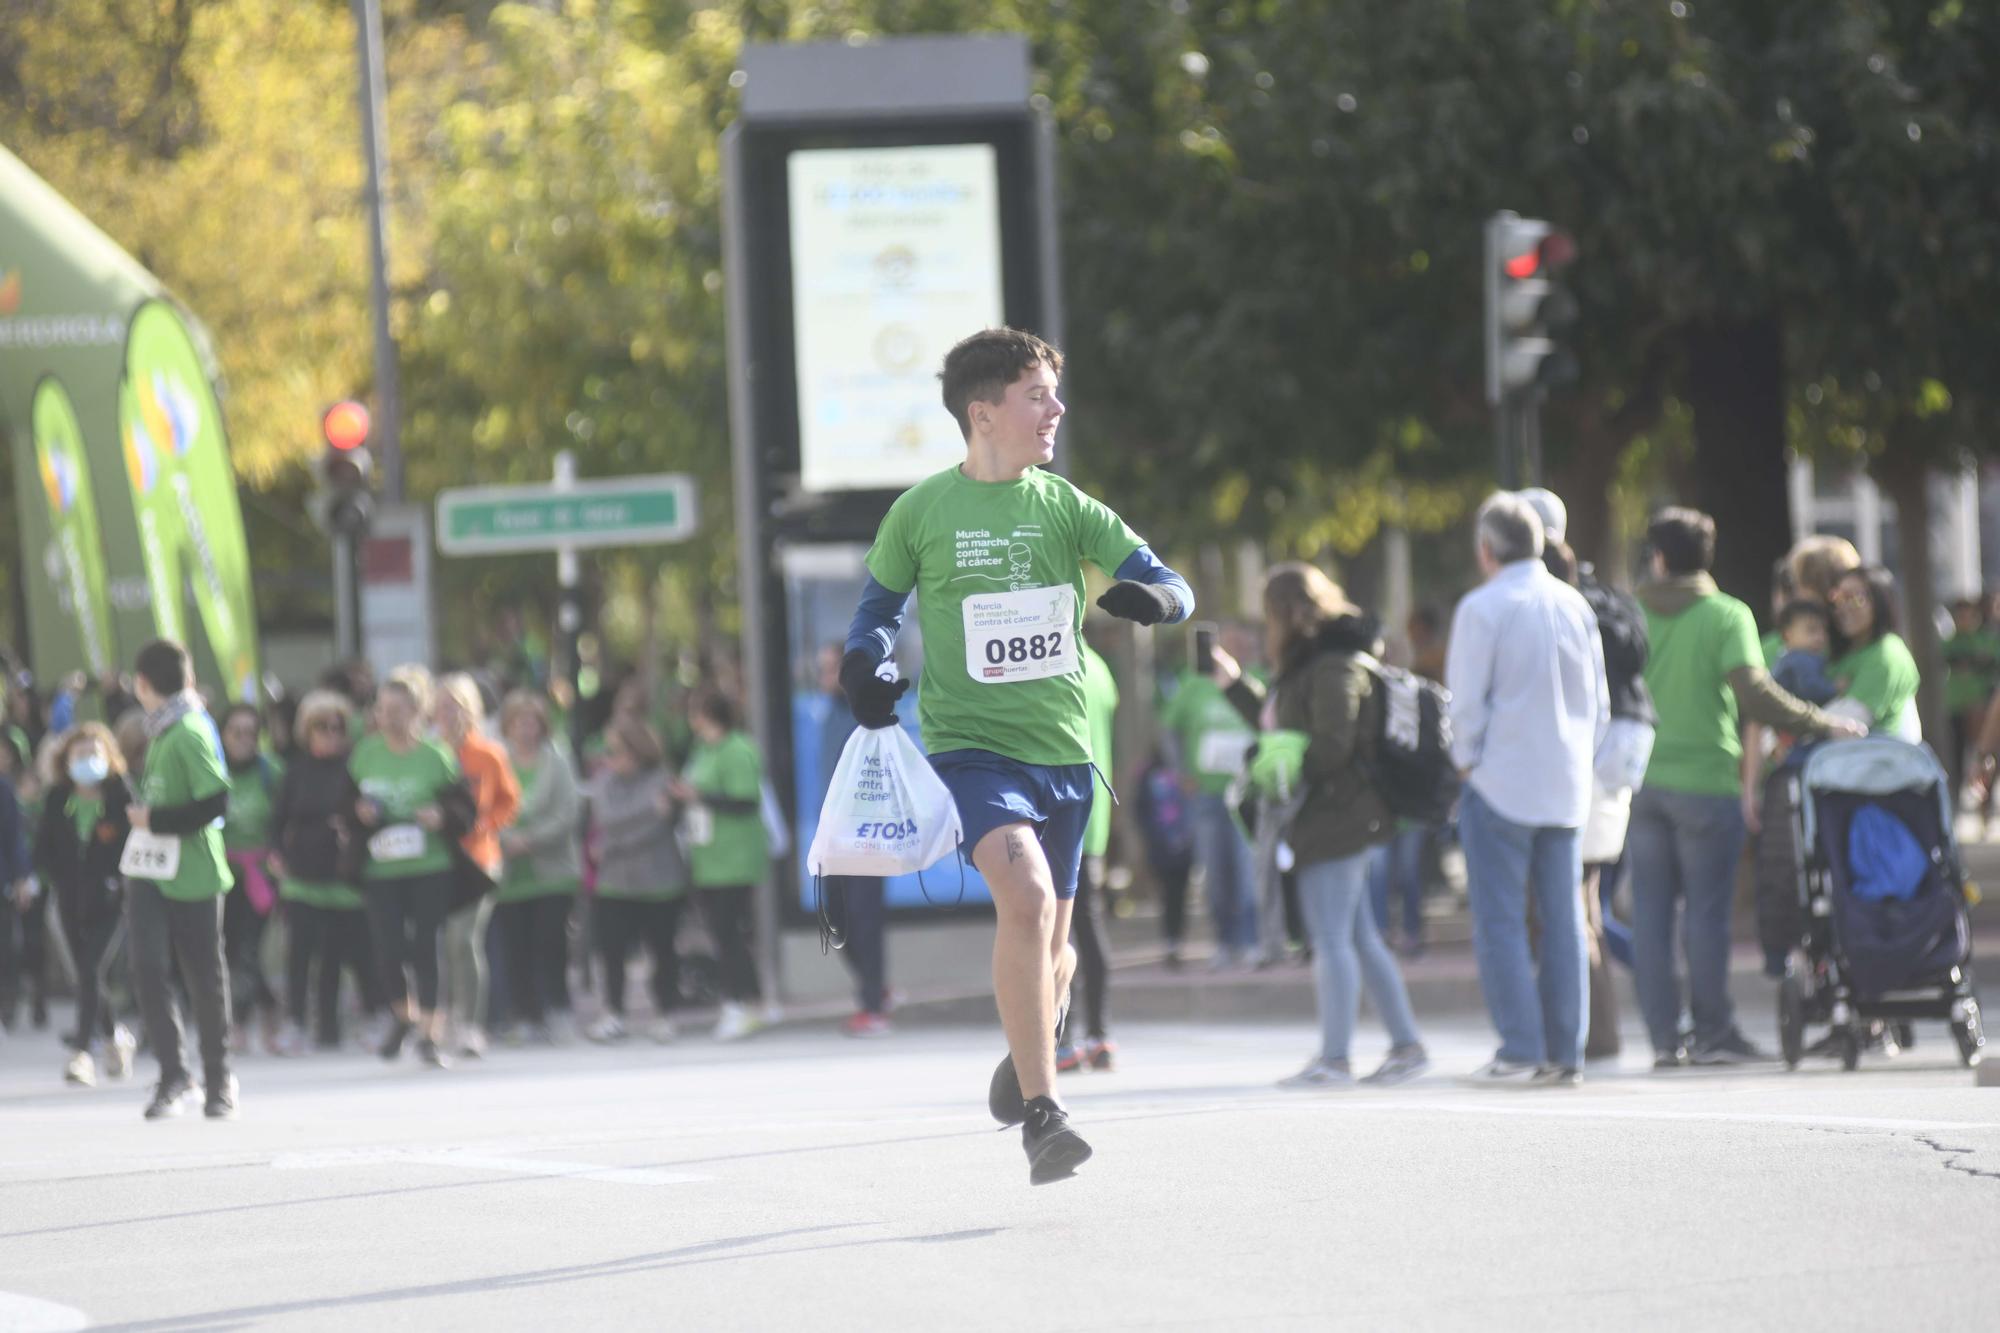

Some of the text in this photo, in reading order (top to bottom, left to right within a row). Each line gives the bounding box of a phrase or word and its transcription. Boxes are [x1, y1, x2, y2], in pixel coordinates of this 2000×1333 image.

[956, 529, 990, 539] Murcia
[955, 537, 1010, 549] en marcha
[956, 548, 989, 558] contra
[956, 556, 1003, 567] el cáncer
[973, 602, 1002, 611] Murcia
[986, 608, 1019, 618] marcha
[974, 614, 1041, 627] contra el cáncer
[985, 631, 1062, 664] 0882
